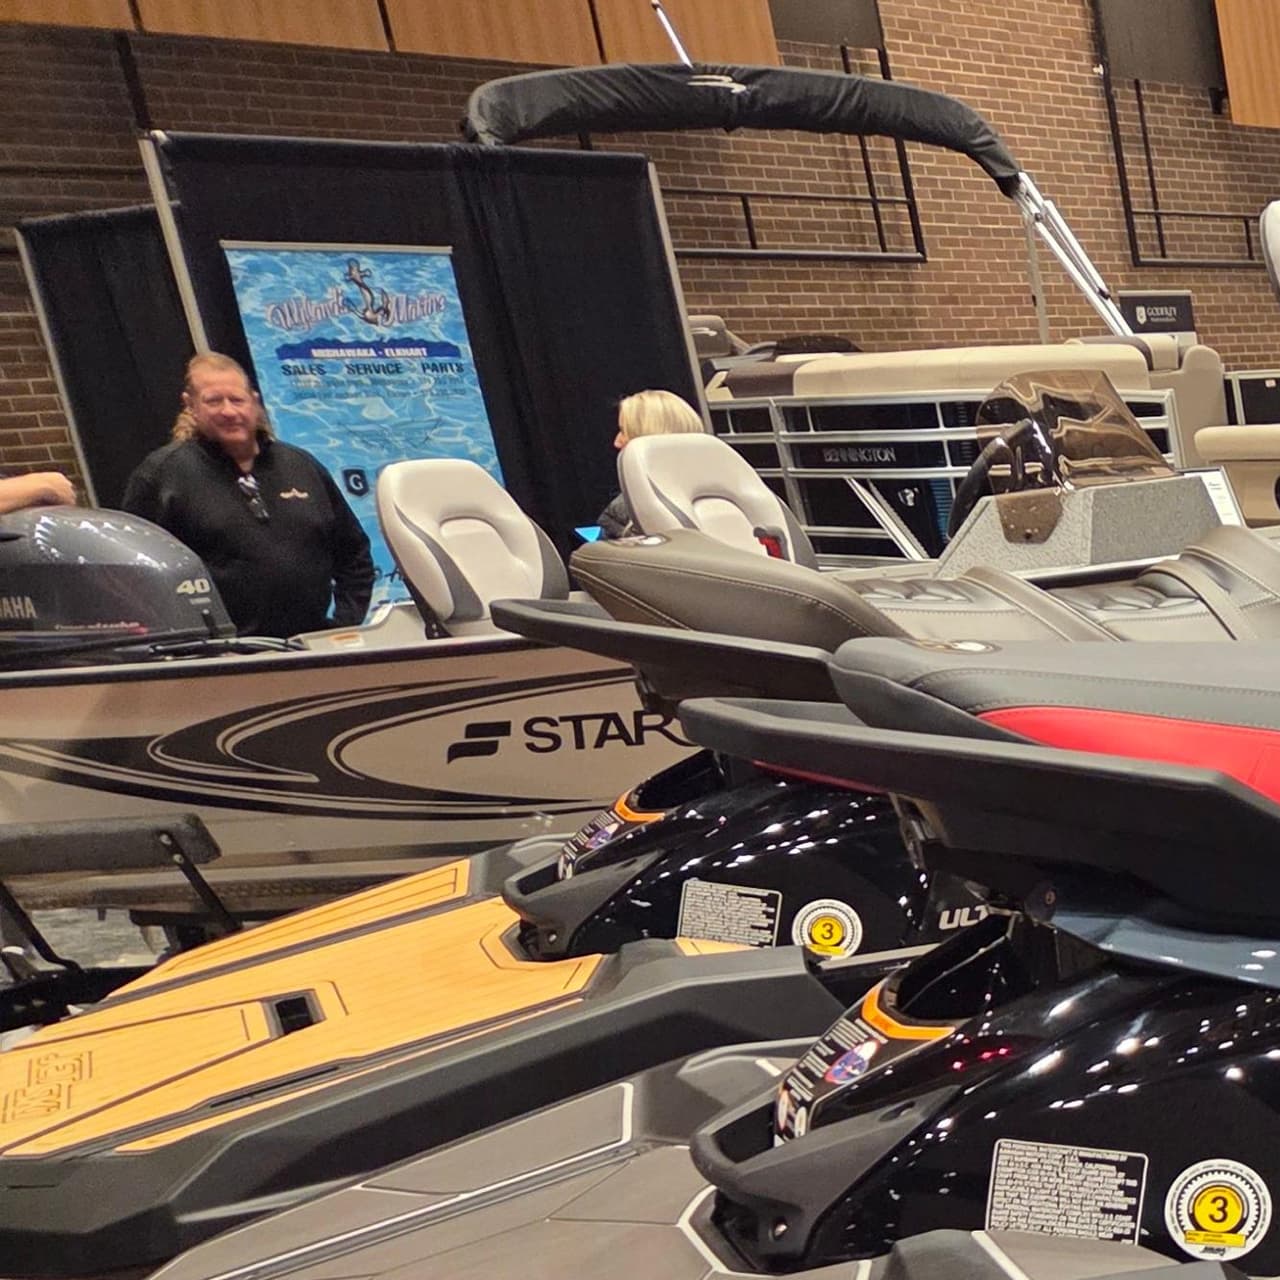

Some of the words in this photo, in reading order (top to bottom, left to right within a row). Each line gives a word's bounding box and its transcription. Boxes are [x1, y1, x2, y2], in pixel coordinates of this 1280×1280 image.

[281, 363, 327, 376] SALES
[346, 362, 402, 375] SERVICE
[421, 361, 465, 374] PARTS
[822, 446, 897, 462] BENNINGTON
[176, 578, 211, 595] 40
[818, 922, 836, 942] 3
[1208, 1195, 1229, 1224] 3
